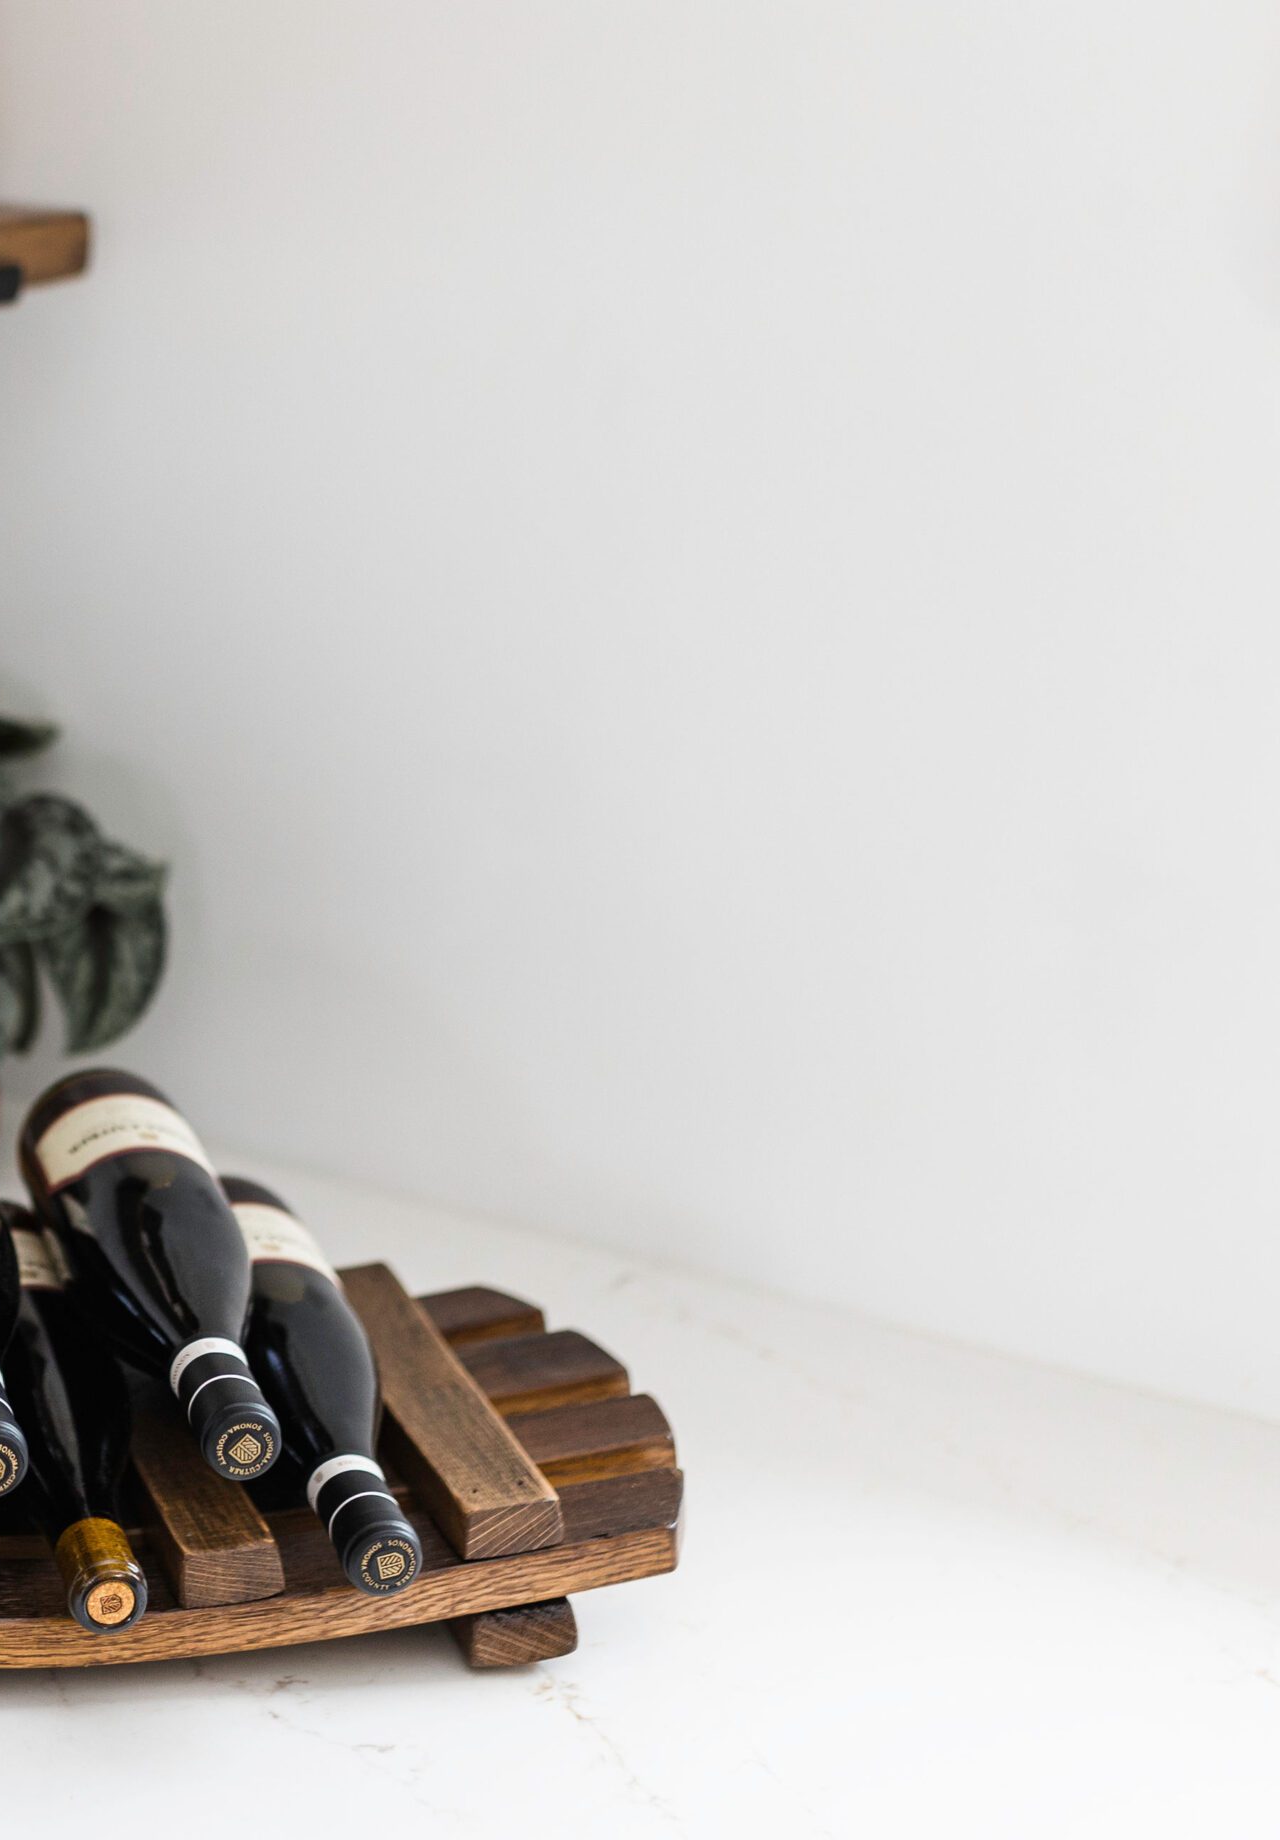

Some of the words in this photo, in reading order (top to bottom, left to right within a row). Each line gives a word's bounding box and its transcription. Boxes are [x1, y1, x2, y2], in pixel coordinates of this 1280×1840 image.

[227, 1423, 263, 1434] SONOMA
[216, 1434, 228, 1465] COUNTY
[361, 1542, 383, 1570] SONOMA
[362, 1572, 390, 1590] COUNTY
